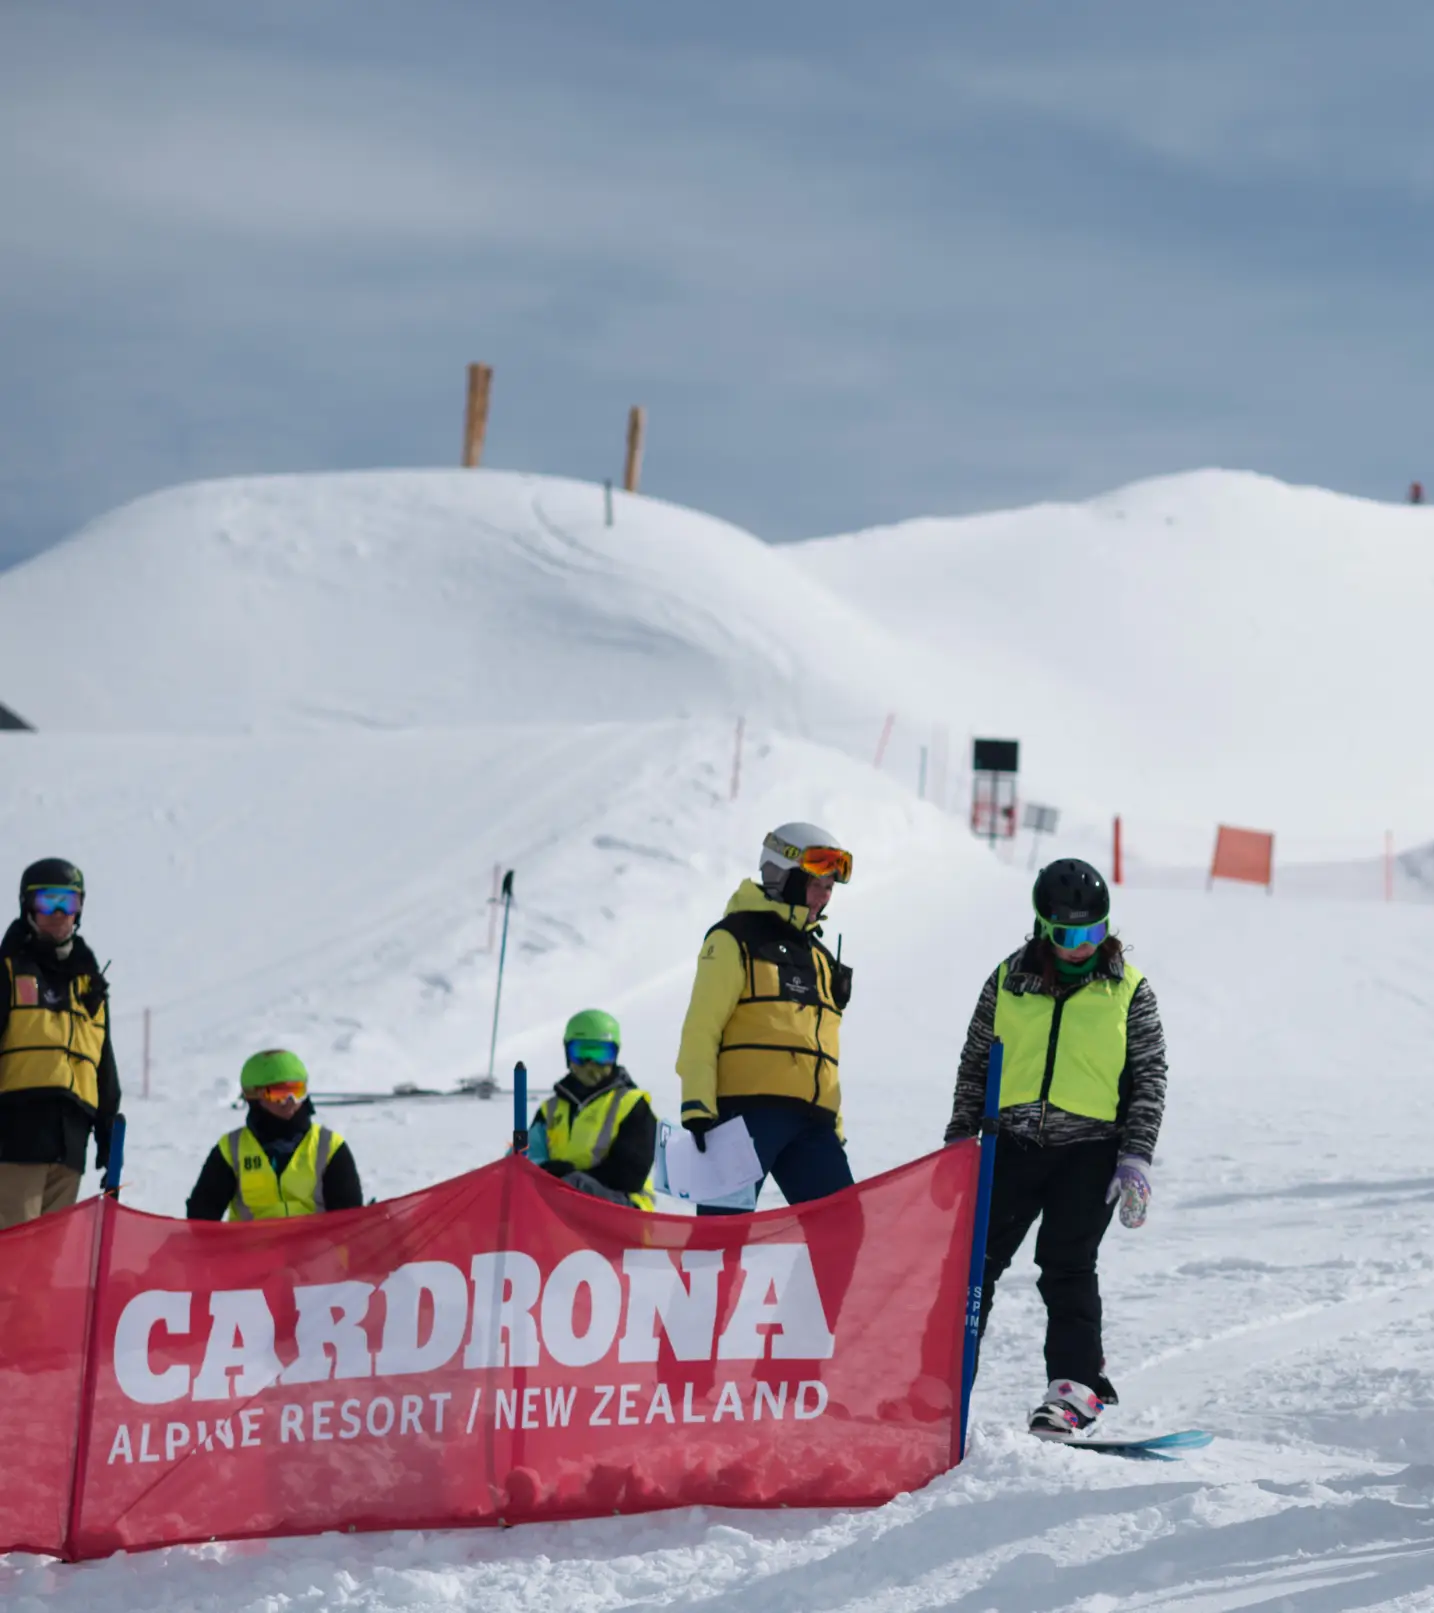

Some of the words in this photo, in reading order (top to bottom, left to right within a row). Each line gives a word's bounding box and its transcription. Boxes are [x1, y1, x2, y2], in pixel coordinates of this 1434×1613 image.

[114, 1243, 835, 1404] CARDRONA
[281, 1392, 451, 1442] RESORT
[466, 1388, 481, 1434] /
[495, 1386, 577, 1429] NEW
[589, 1380, 828, 1426] ZEALAND
